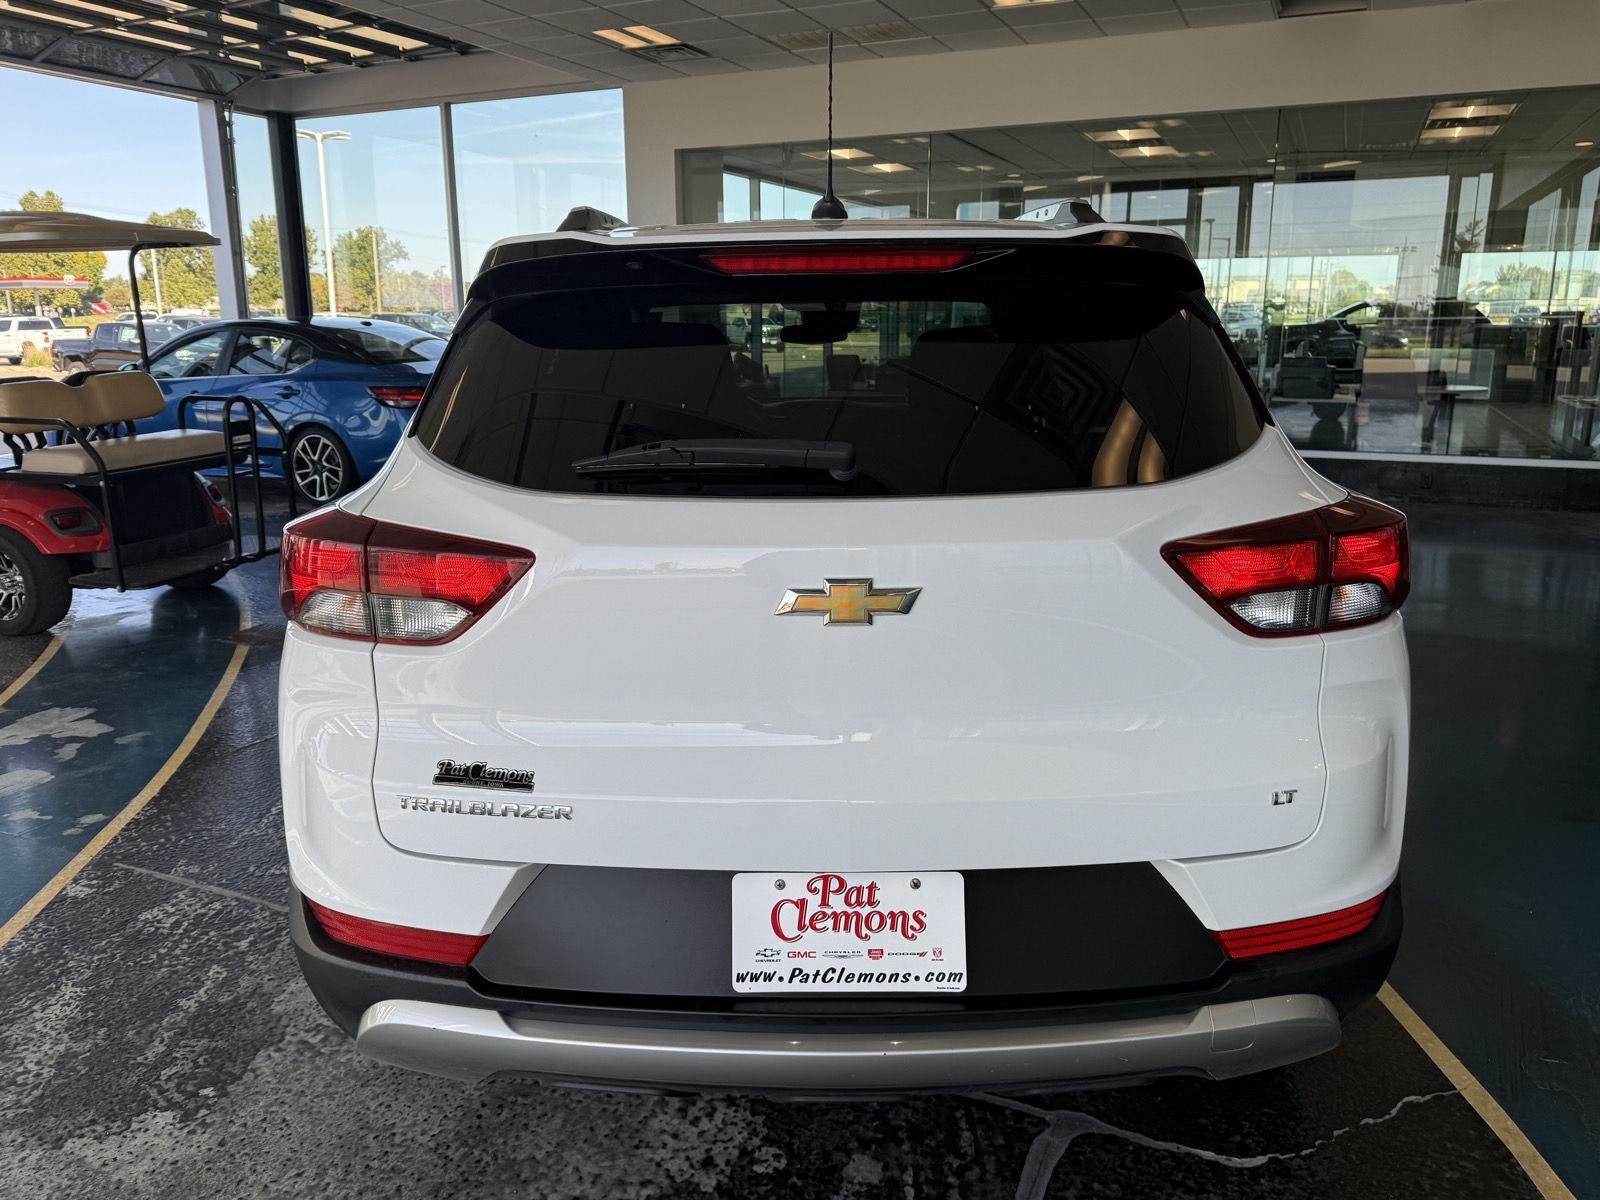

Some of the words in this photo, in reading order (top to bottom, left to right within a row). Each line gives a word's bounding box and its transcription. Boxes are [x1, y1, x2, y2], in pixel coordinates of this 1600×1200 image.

[436, 759, 466, 776] Pat
[468, 761, 535, 784] Clemons
[397, 794, 573, 820] TRAILBLAZER
[1272, 789, 1298, 805] LT
[806, 873, 881, 909] Pat
[770, 897, 927, 943] Clemons
[787, 951, 817, 959] GMC
[735, 966, 964, 984] www.PatClemons.com
